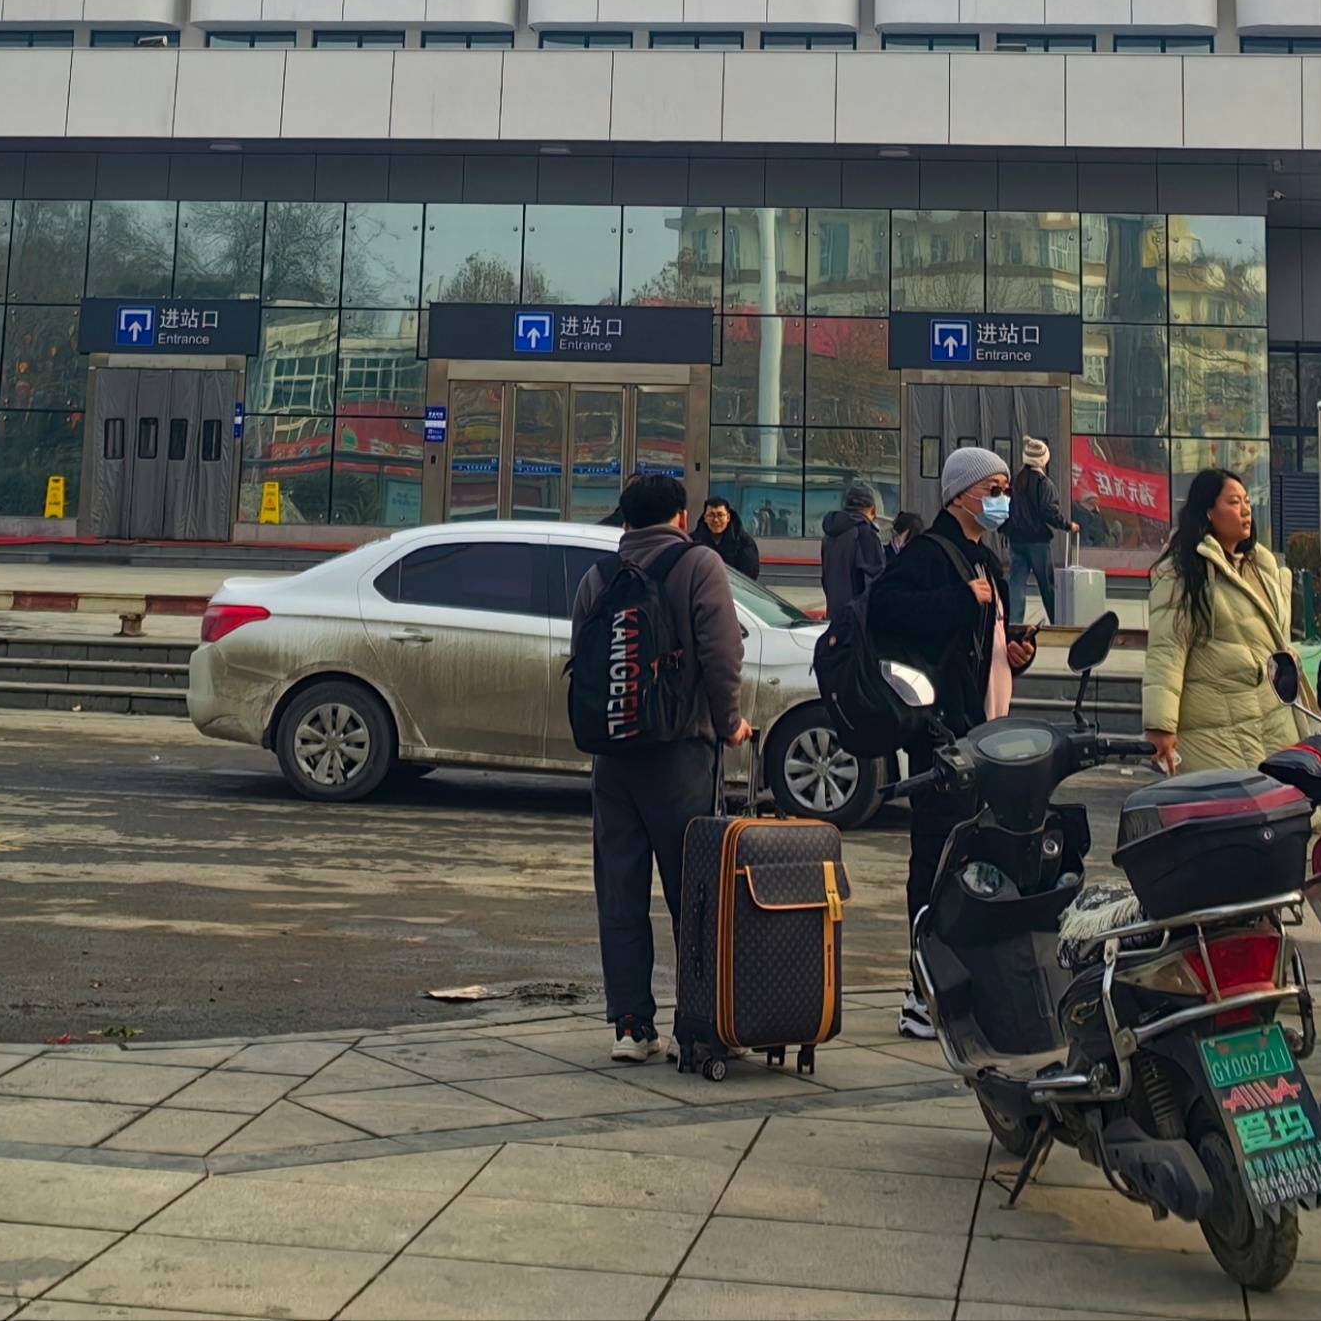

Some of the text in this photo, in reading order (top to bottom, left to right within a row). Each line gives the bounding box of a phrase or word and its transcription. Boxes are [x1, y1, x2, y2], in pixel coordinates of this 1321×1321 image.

[159, 308, 219, 328] 进站口
[560, 315, 622, 336] 进站口
[158, 332, 210, 345] Entrance
[977, 323, 1040, 344] 进站口
[559, 338, 612, 351] Entrance
[976, 348, 1031, 361] Entrance
[607, 608, 641, 739] KANGBEILI
[1234, 1104, 1315, 1154] 爱玛
